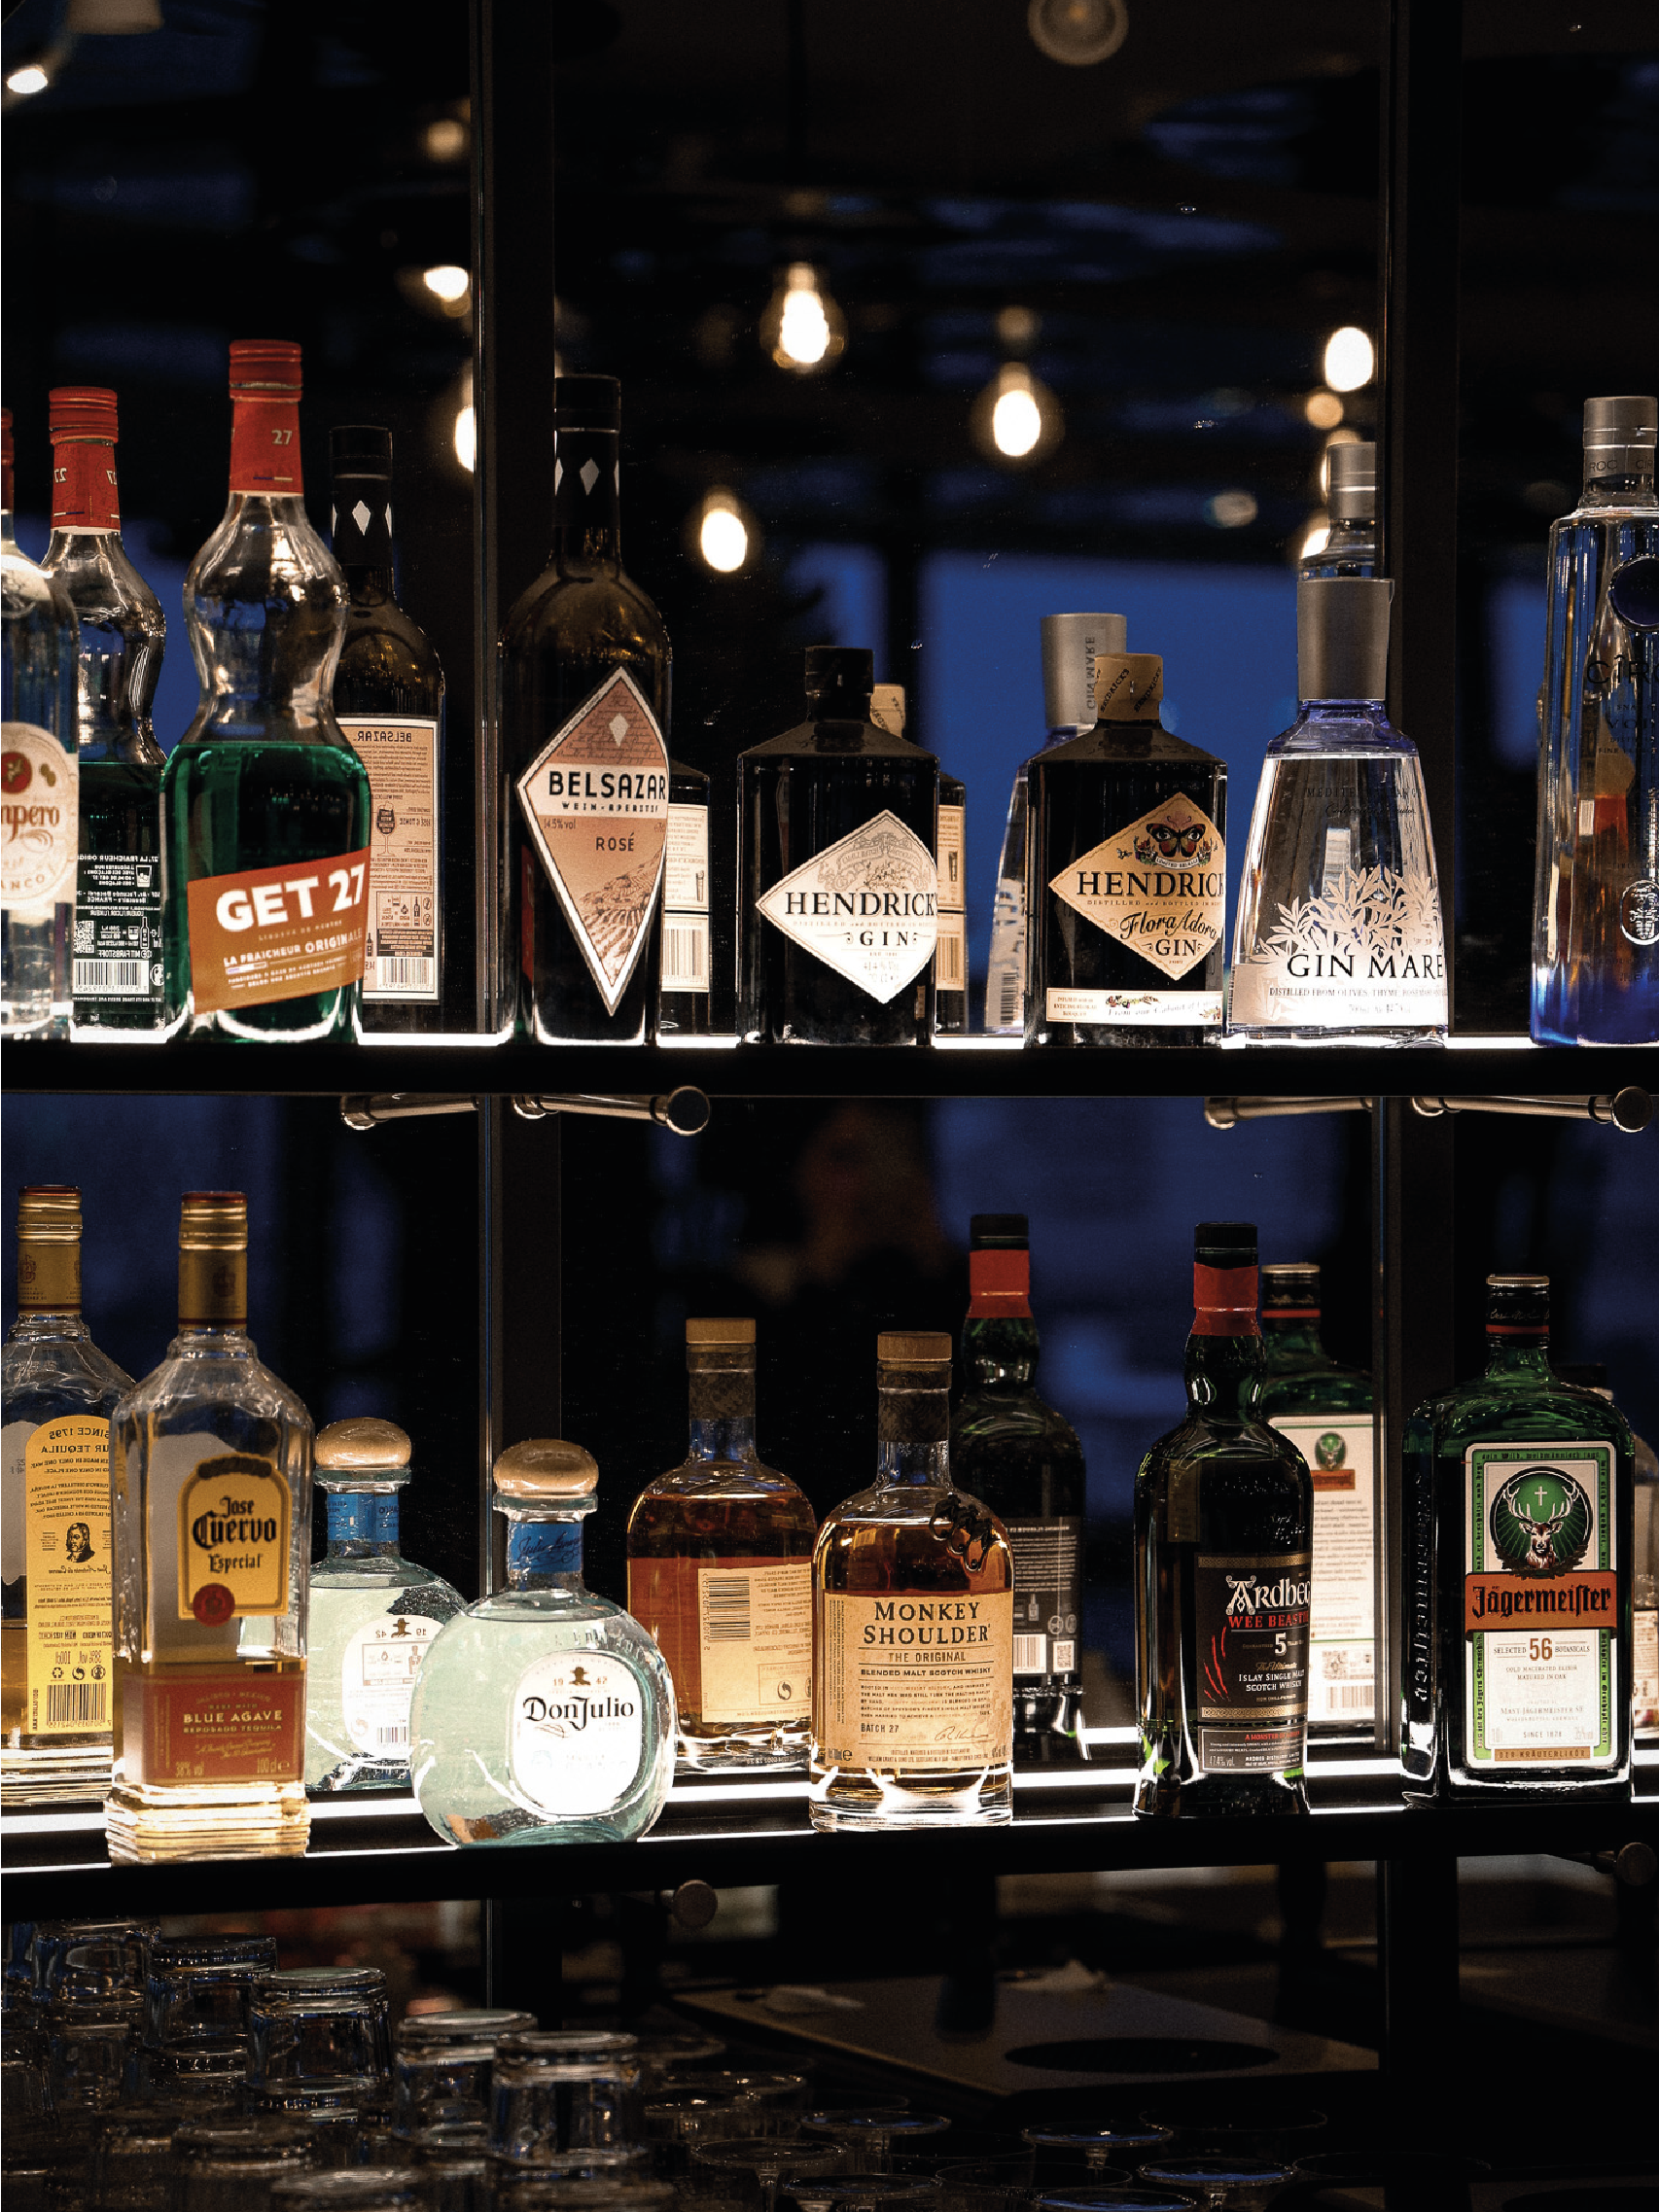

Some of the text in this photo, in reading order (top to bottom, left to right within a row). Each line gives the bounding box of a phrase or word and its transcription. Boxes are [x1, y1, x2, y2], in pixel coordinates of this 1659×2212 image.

[270, 430, 293, 445] 27
[1587, 654, 1659, 685] CÎR
[548, 770, 667, 800] BELSAZAR
[595, 832, 634, 852] ROSÉ
[216, 876, 319, 932] GET
[328, 862, 366, 912] 27
[785, 892, 937, 917] HENDRICK'
[1119, 911, 1175, 940] Flora
[223, 928, 363, 967] LA FRAICHEUR ORIGINALE
[860, 930, 909, 946] GIN
[1155, 939, 1198, 957] GIN
[1288, 954, 1444, 979] GIN MARE
[219, 1495, 255, 1518] Jose
[192, 1510, 277, 1550] Cuervo
[208, 1553, 264, 1573] Especial
[1472, 1584, 1611, 1618] Jägermeister
[874, 1601, 980, 1622] MONKEY
[1227, 1615, 1263, 1628] WEE
[863, 1624, 989, 1645] SHOULDER
[1274, 1632, 1287, 1657] 5
[889, 1652, 967, 1663] THE ORIGINAL
[1529, 1637, 1553, 1662] 56
[965, 1667, 991, 1675] WHISKY
[1238, 1673, 1263, 1682] ISLAY
[1266, 1671, 1291, 1681] SINGLE
[1246, 1683, 1277, 1692] SCOTCH
[183, 1709, 283, 1724] BLUE AGAVE
[183, 1724, 283, 1734] REPOSADO TEQUILA
[861, 1723, 900, 1734] BATCH 27
[1520, 1749, 1585, 1759] KRÄUTERLIKÖR
